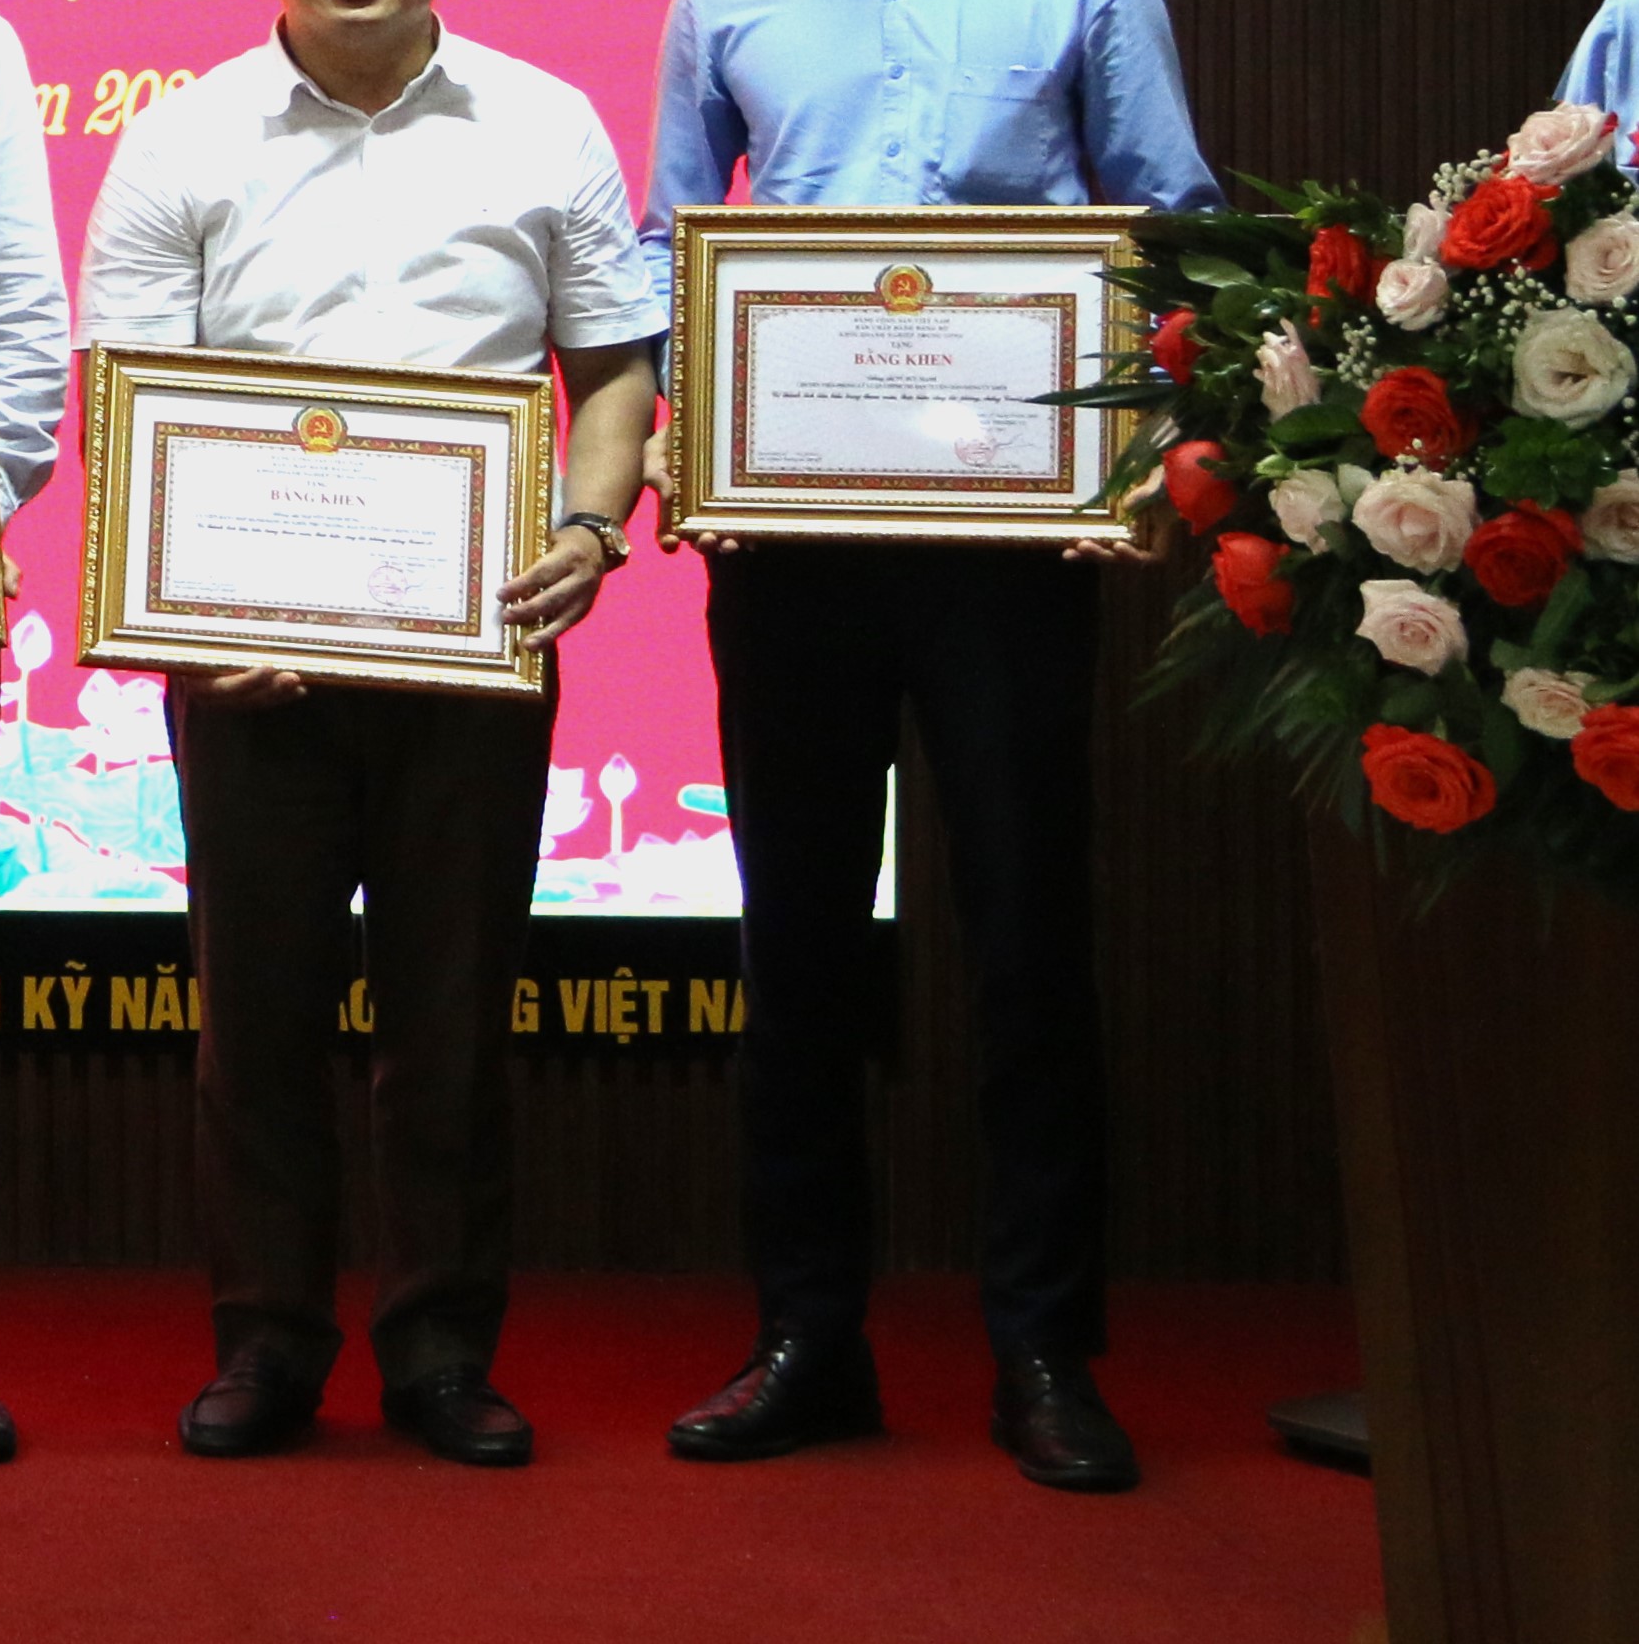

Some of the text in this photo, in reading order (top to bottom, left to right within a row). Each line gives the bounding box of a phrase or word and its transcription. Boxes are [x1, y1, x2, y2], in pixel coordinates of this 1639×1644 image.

[905, 352, 953, 366] KHEN
[23, 959, 92, 1030] KỸ
[558, 966, 670, 1044] VIỆT
